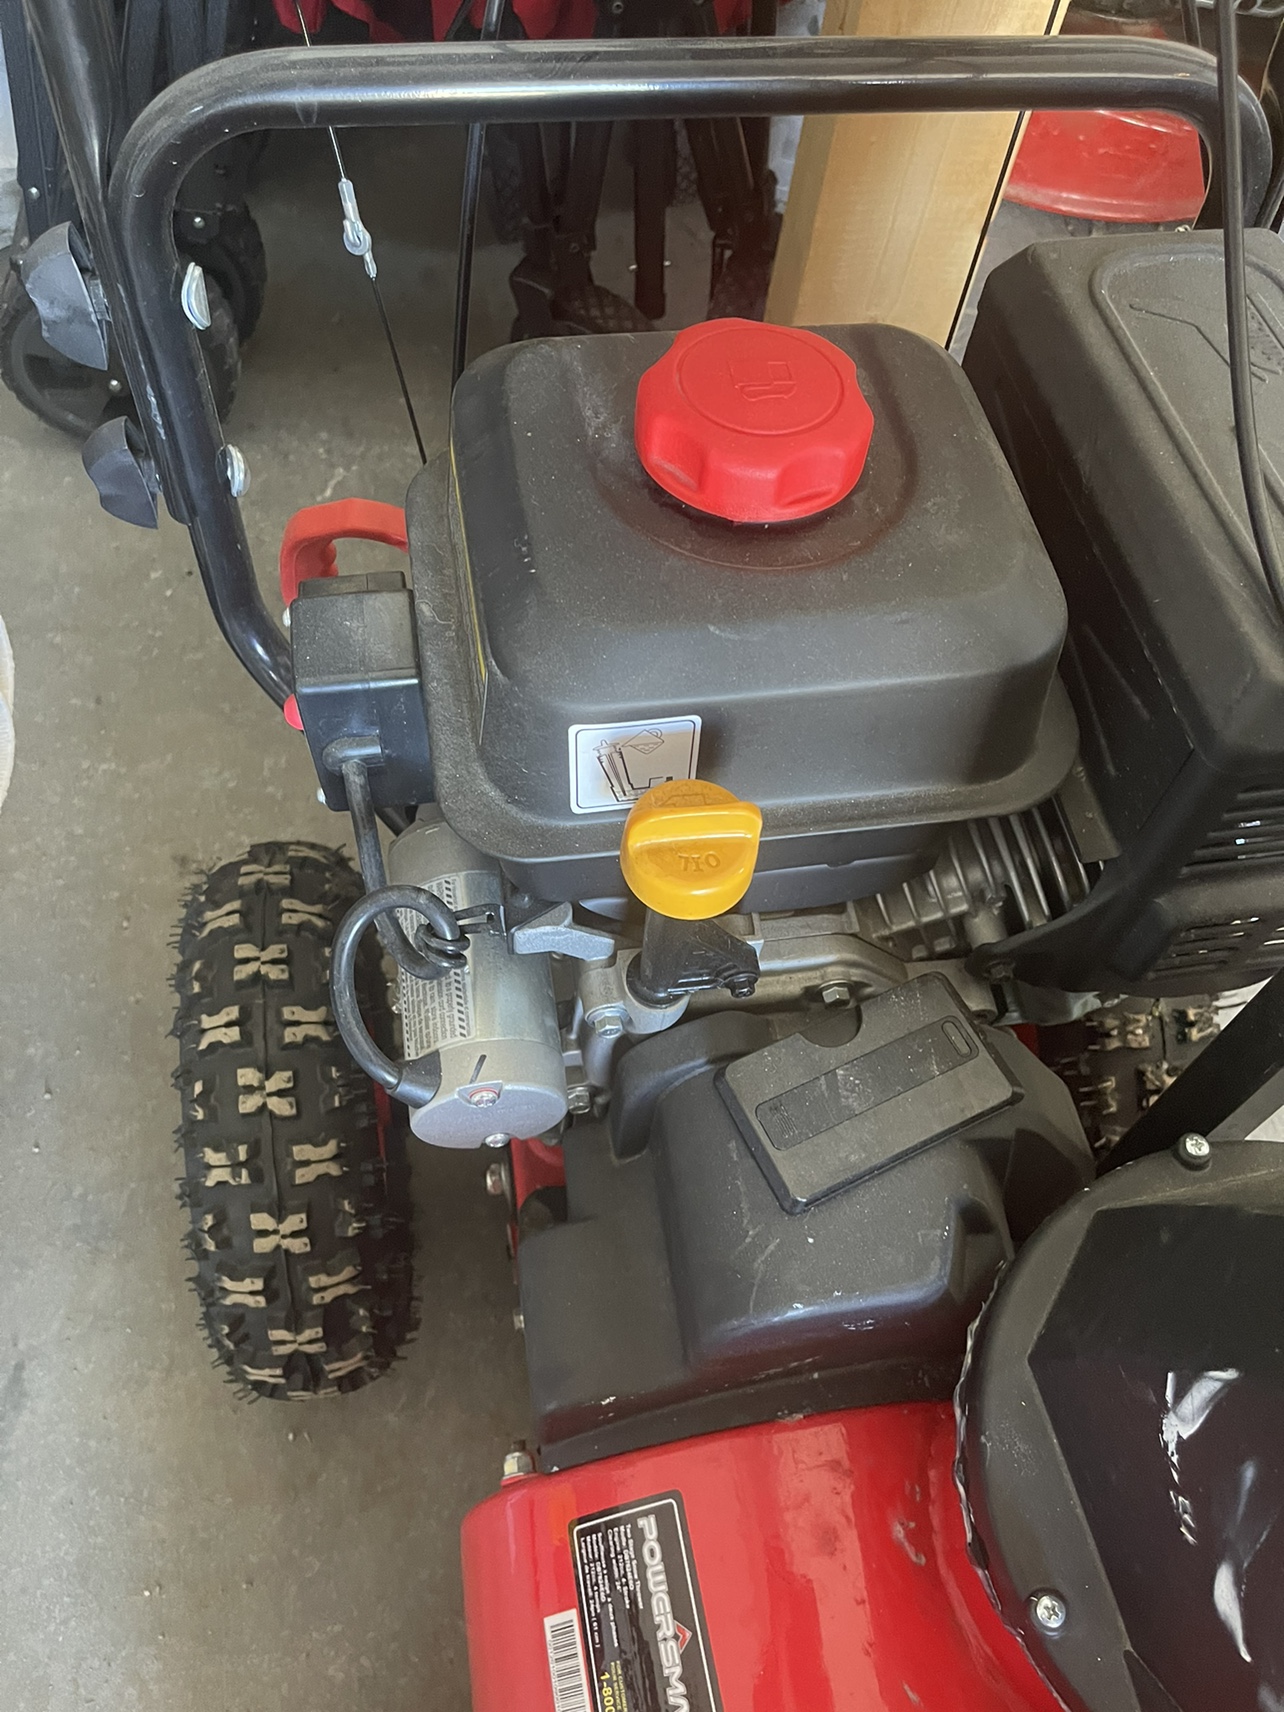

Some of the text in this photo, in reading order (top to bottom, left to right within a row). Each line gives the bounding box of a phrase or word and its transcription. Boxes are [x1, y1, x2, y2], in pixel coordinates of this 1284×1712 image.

[677, 851, 721, 873] OIL
[444, 991, 454, 1013] properly
[446, 1013, 457, 1039] grounded
[596, 1531, 607, 1568] Souffleuse
[606, 1528, 615, 1557] Clearing
[624, 1523, 645, 1609] Two Stage Snow Thrower
[593, 1590, 601, 1613] temps
[621, 1585, 631, 1609] Stroke
[609, 1661, 621, 1710] POUR SERVICE
